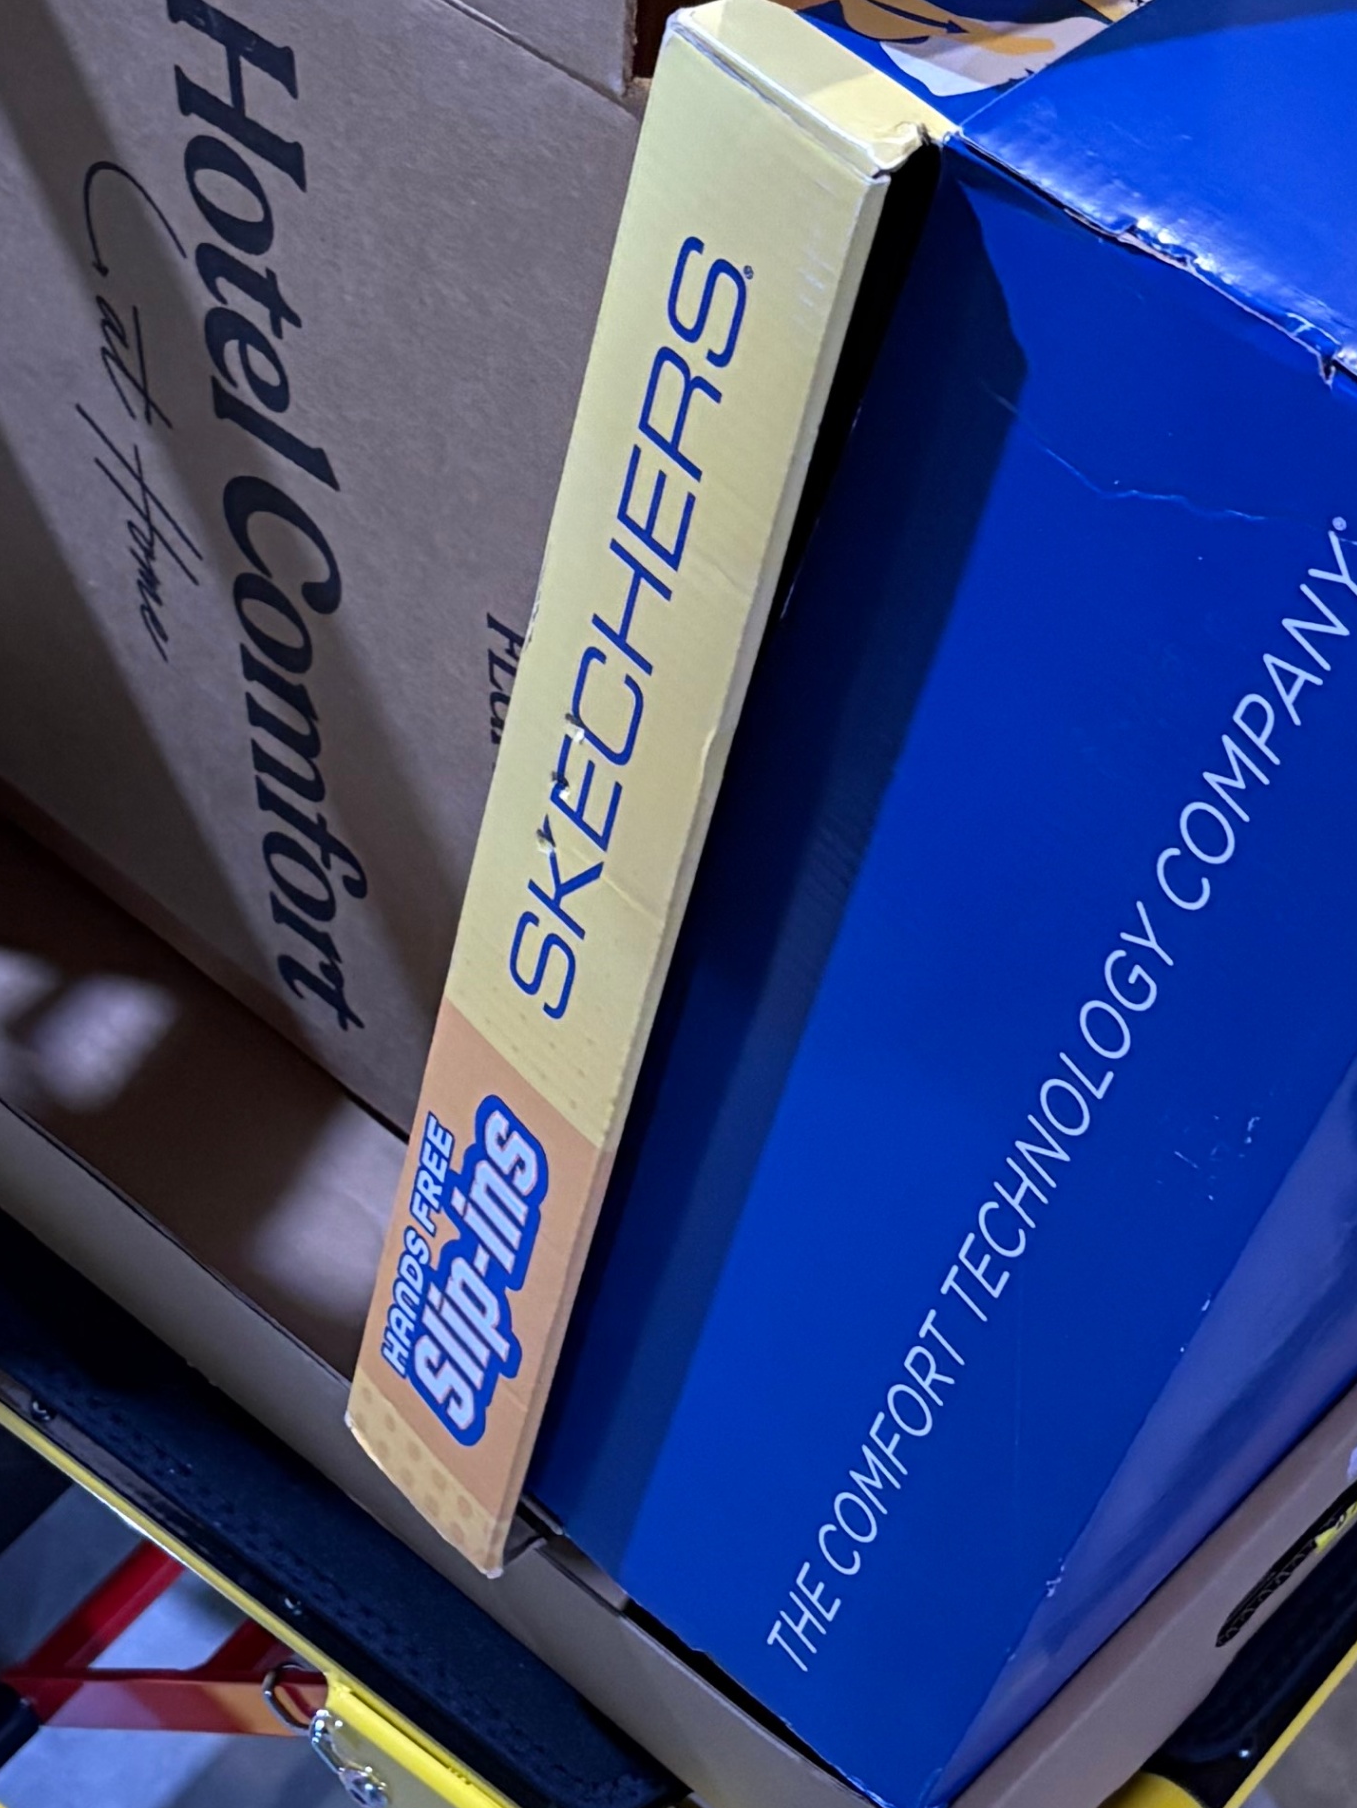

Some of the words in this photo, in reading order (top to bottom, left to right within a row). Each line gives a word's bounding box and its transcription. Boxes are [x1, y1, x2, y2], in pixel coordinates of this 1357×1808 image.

[76, 402, 203, 664] Home
[221, 473, 367, 1031] Comfort
[380, 1225, 432, 1379] HANDS
[409, 1110, 455, 1237] FREE
[766, 1562, 842, 1673] THE
[817, 1308, 966, 1575] COMFORT
[939, 900, 1175, 1322] TECHNOLOGY
